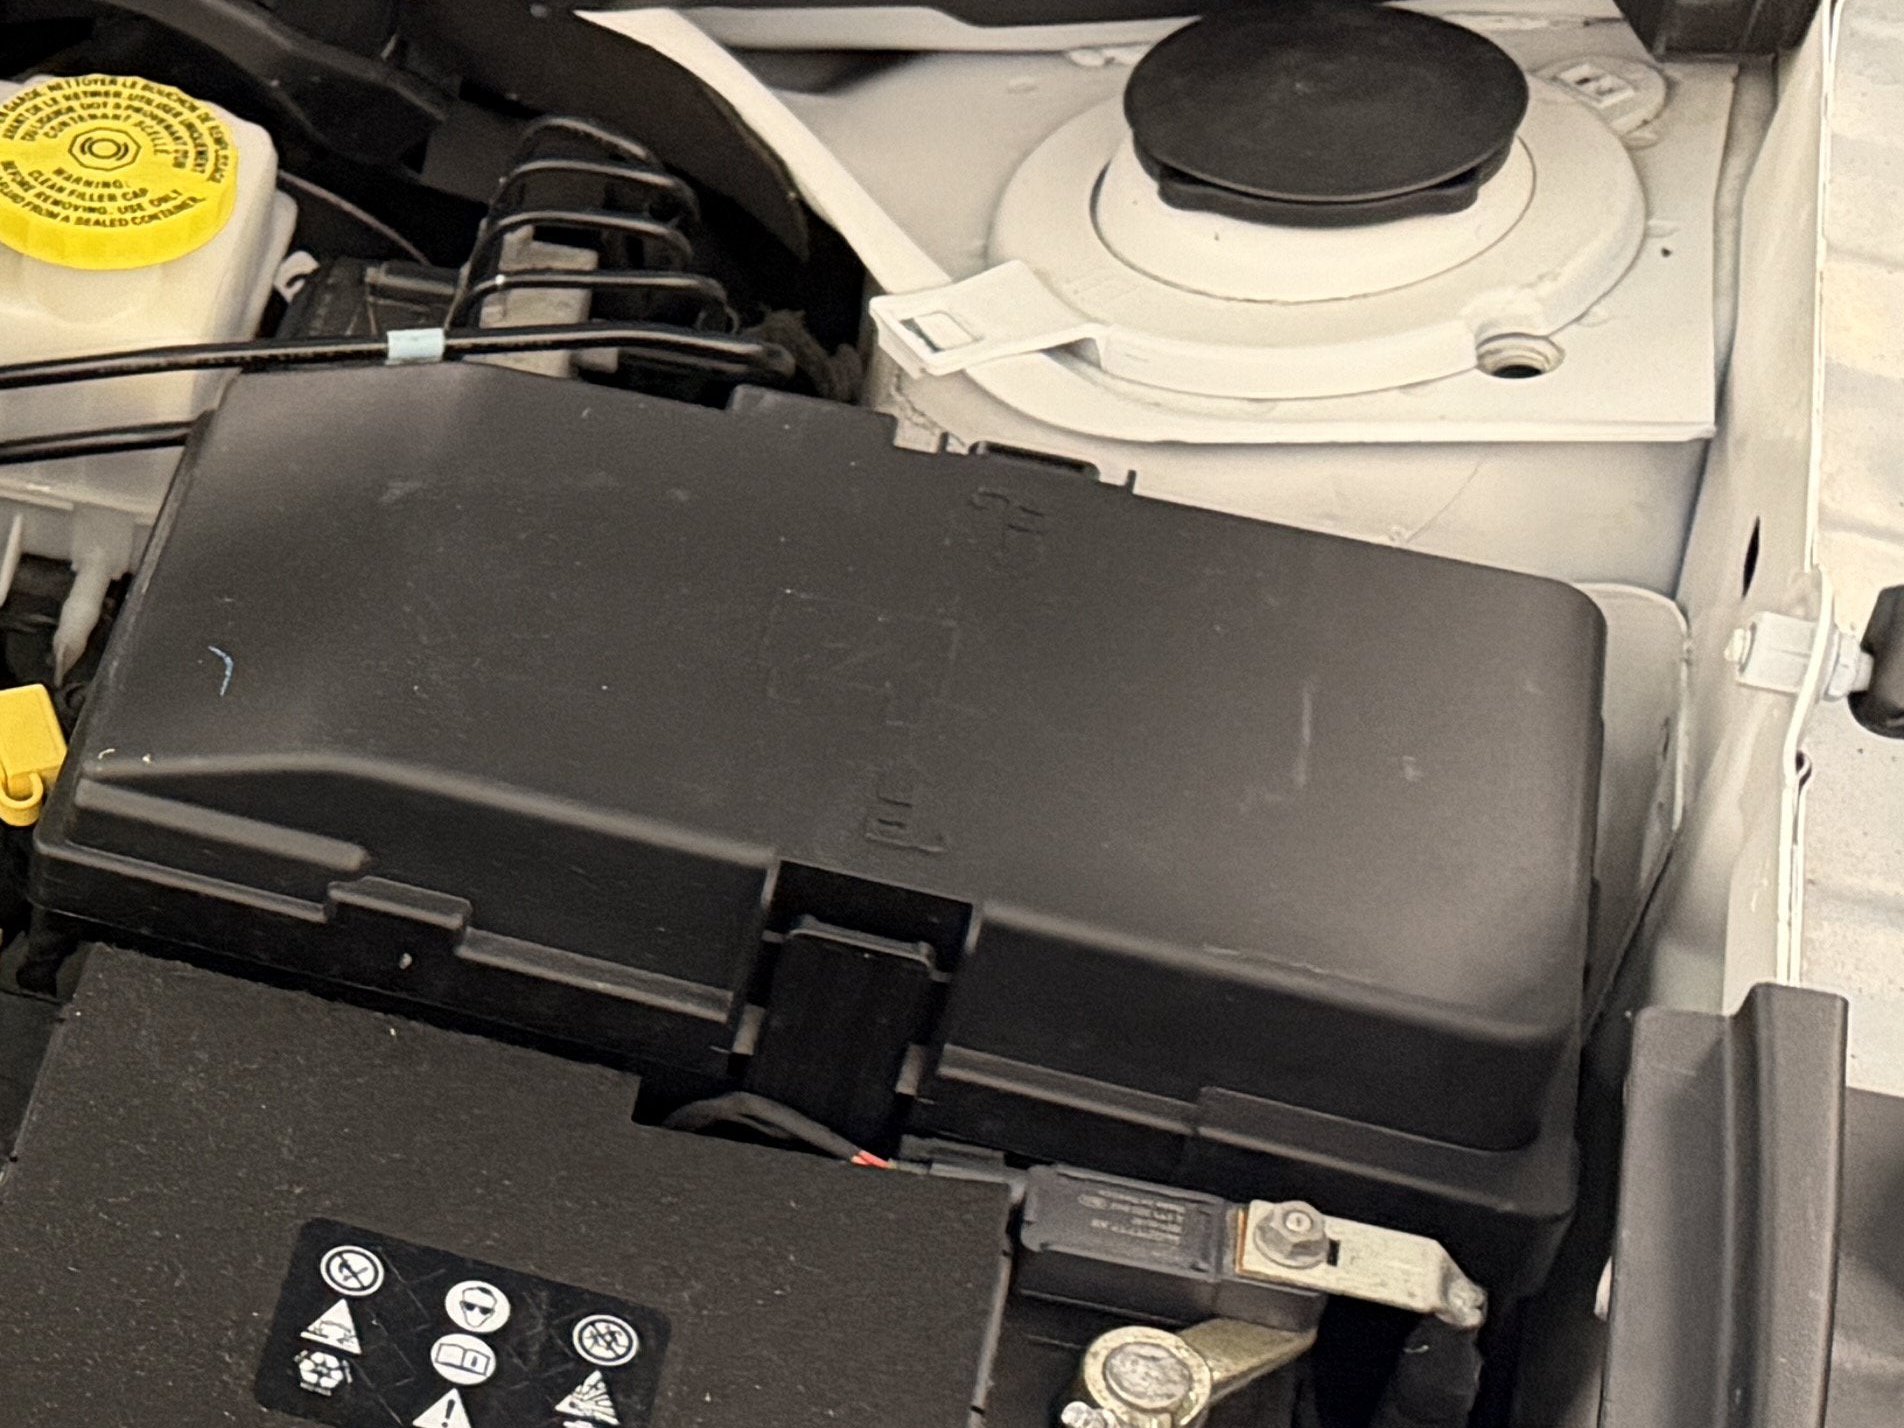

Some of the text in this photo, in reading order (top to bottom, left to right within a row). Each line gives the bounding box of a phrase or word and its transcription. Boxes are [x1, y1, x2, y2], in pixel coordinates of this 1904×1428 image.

[28, 170, 149, 203] CLEAN FILLER CAP
[117, 202, 147, 215] USE
[148, 188, 183, 208] ONLY
[74, 215, 129, 228] SEALED
